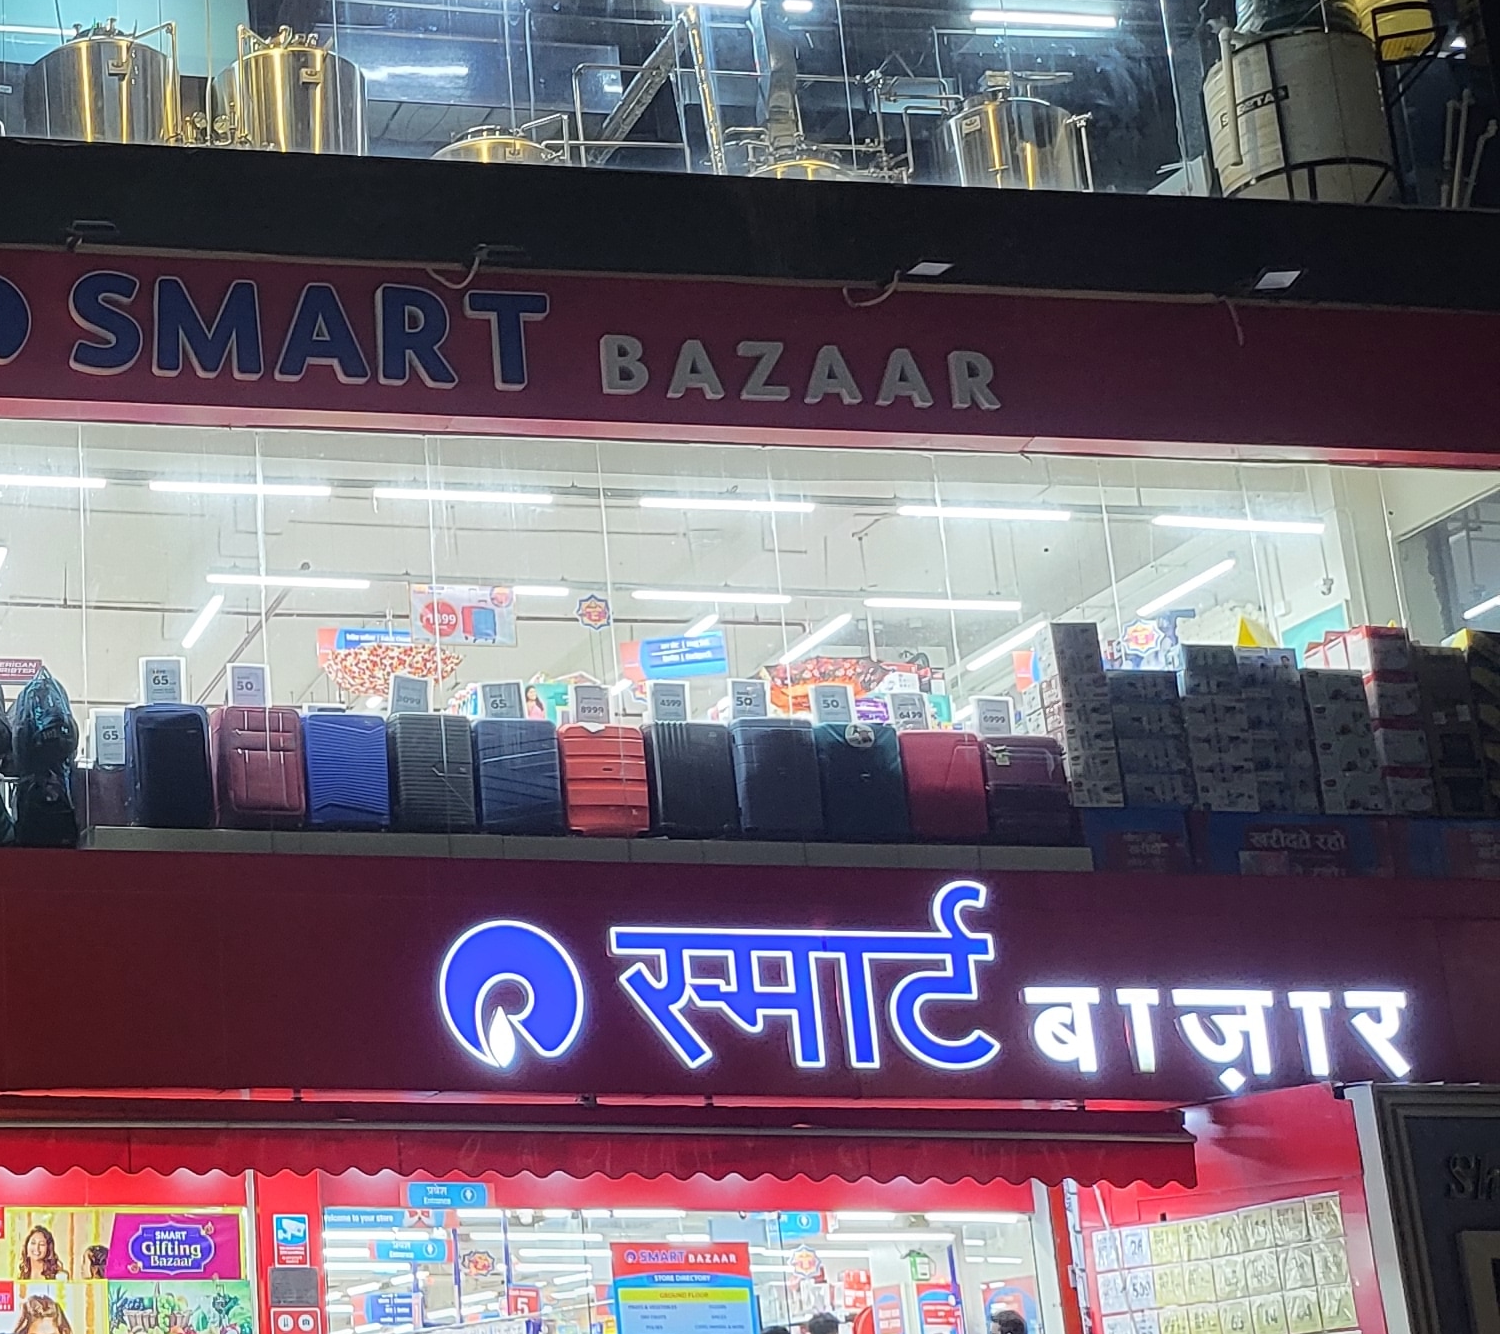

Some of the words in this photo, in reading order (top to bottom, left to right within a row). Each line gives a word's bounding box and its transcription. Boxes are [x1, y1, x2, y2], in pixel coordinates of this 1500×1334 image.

[68, 269, 550, 392] SMART
[599, 333, 1001, 411] BAZAAR
[152, 675, 169, 686] 65
[237, 681, 254, 691] 50
[491, 699, 508, 709] 65
[736, 695, 753, 706] 50
[822, 699, 839, 708] 50
[102, 730, 119, 741] 65
[606, 878, 1001, 1072] स्मार्ट
[1021, 986, 1409, 1094] बाज़ार
[426, 1184, 448, 1196] प्रवेश
[155, 1230, 187, 1240] SMART
[141, 1241, 201, 1259] Gifting
[150, 1256, 193, 1267] Bazaar
[640, 1250, 686, 1263] SMART
[687, 1253, 738, 1264] BAZAAR
[654, 1274, 675, 1282] STORE
[675, 1274, 711, 1283] DIRECTORY
